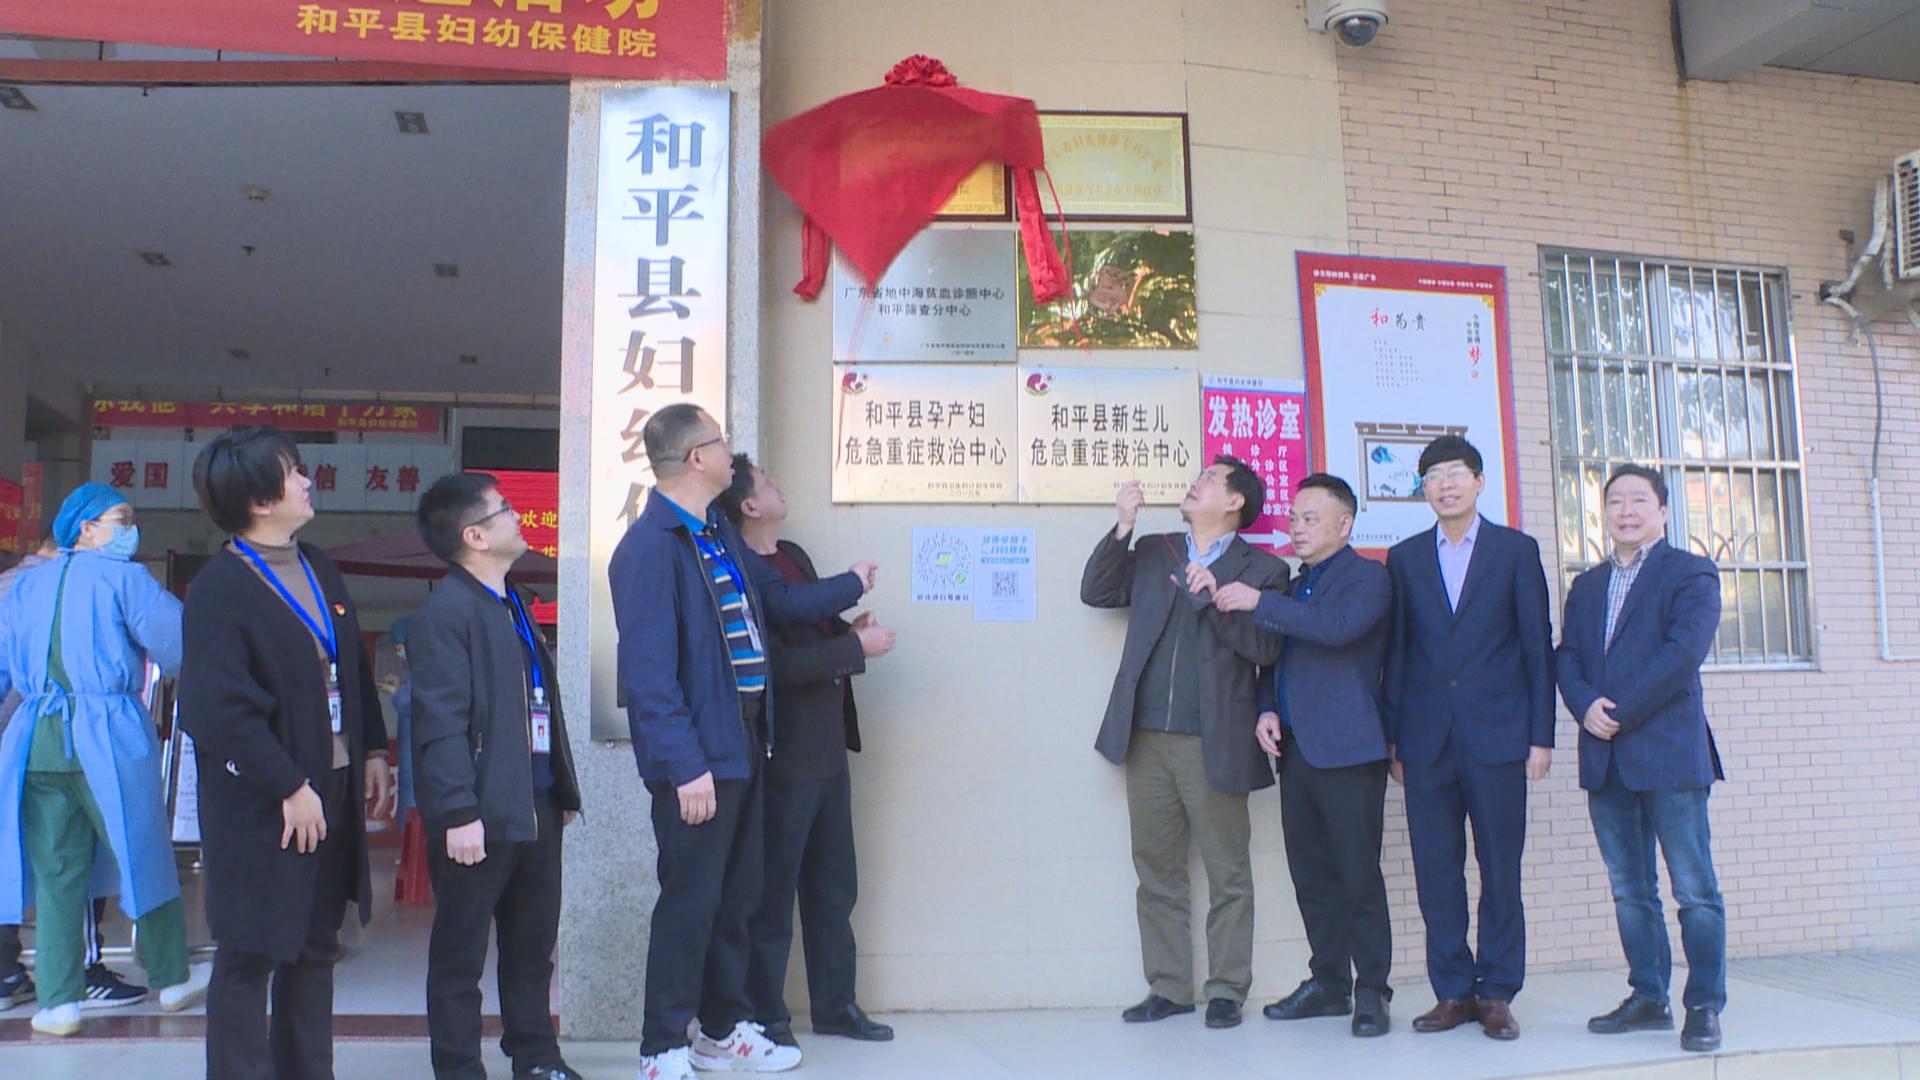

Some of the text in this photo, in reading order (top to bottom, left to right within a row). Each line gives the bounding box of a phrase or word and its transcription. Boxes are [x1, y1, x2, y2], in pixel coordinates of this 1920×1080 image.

[297, 7, 657, 58] 和平县妇幼保健院
[617, 112, 706, 533] 和平县妇
[878, 303, 972, 317] 和平筛查分中心
[866, 400, 985, 429] 和平县孕产妇
[1051, 403, 1169, 433] 和平县新生儿
[1208, 395, 1301, 440] 发热诊室
[845, 436, 1007, 466] 危急重症救治中心
[1031, 438, 1190, 468] 危急重症救治中心
[110, 461, 169, 489] 爱国
[365, 465, 420, 492] 友善
[521, 509, 559, 528] 欢迎
